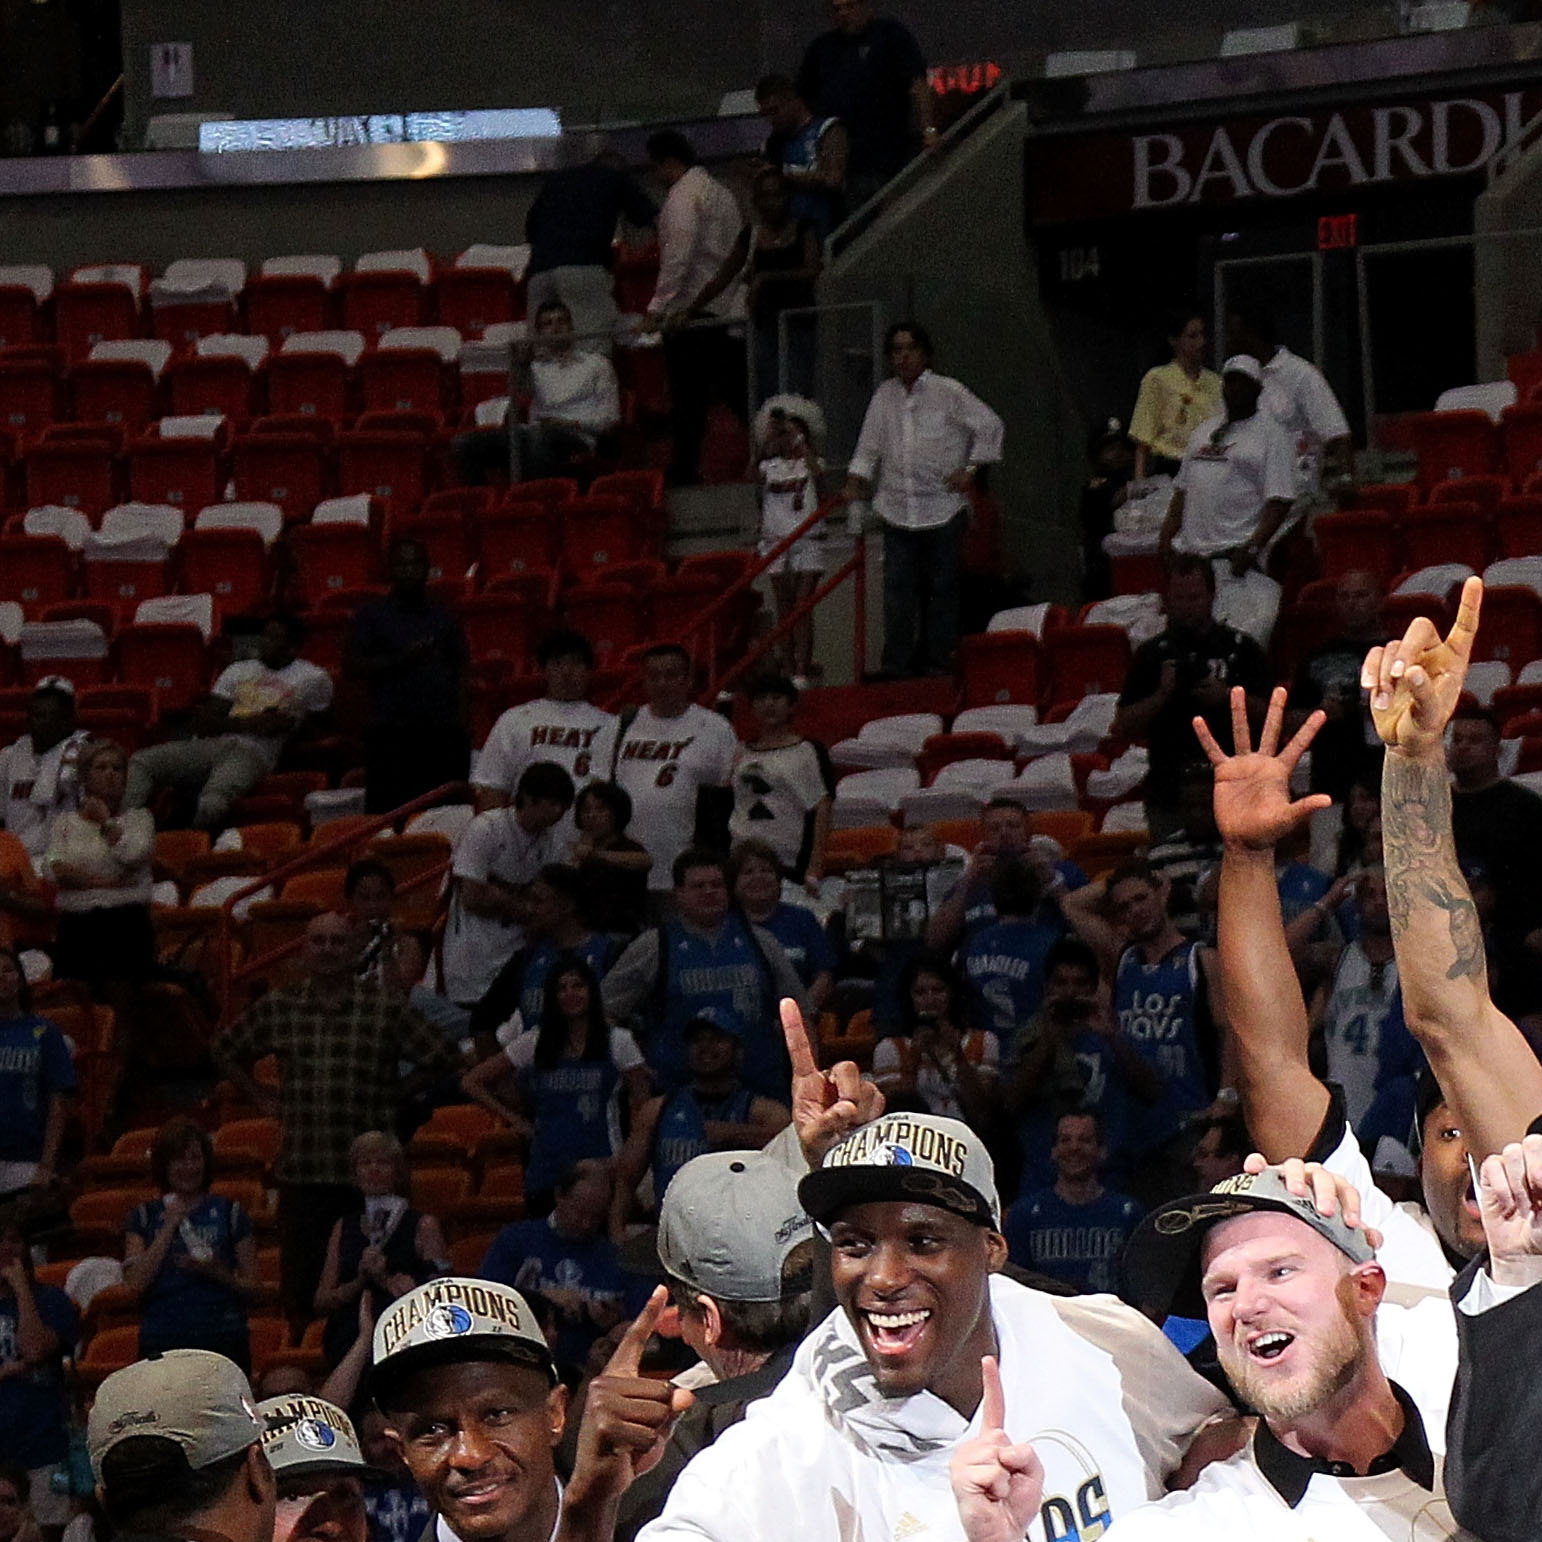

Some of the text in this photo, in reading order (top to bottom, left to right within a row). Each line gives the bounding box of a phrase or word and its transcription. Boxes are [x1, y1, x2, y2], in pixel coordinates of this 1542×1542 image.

[1131, 93, 1526, 210] BACARDI
[530, 725, 601, 748] HEAT
[621, 737, 694, 761] HEAT
[574, 752, 590, 777] 6
[655, 764, 677, 787] 6
[384, 1284, 520, 1352] CHAMPIONS
